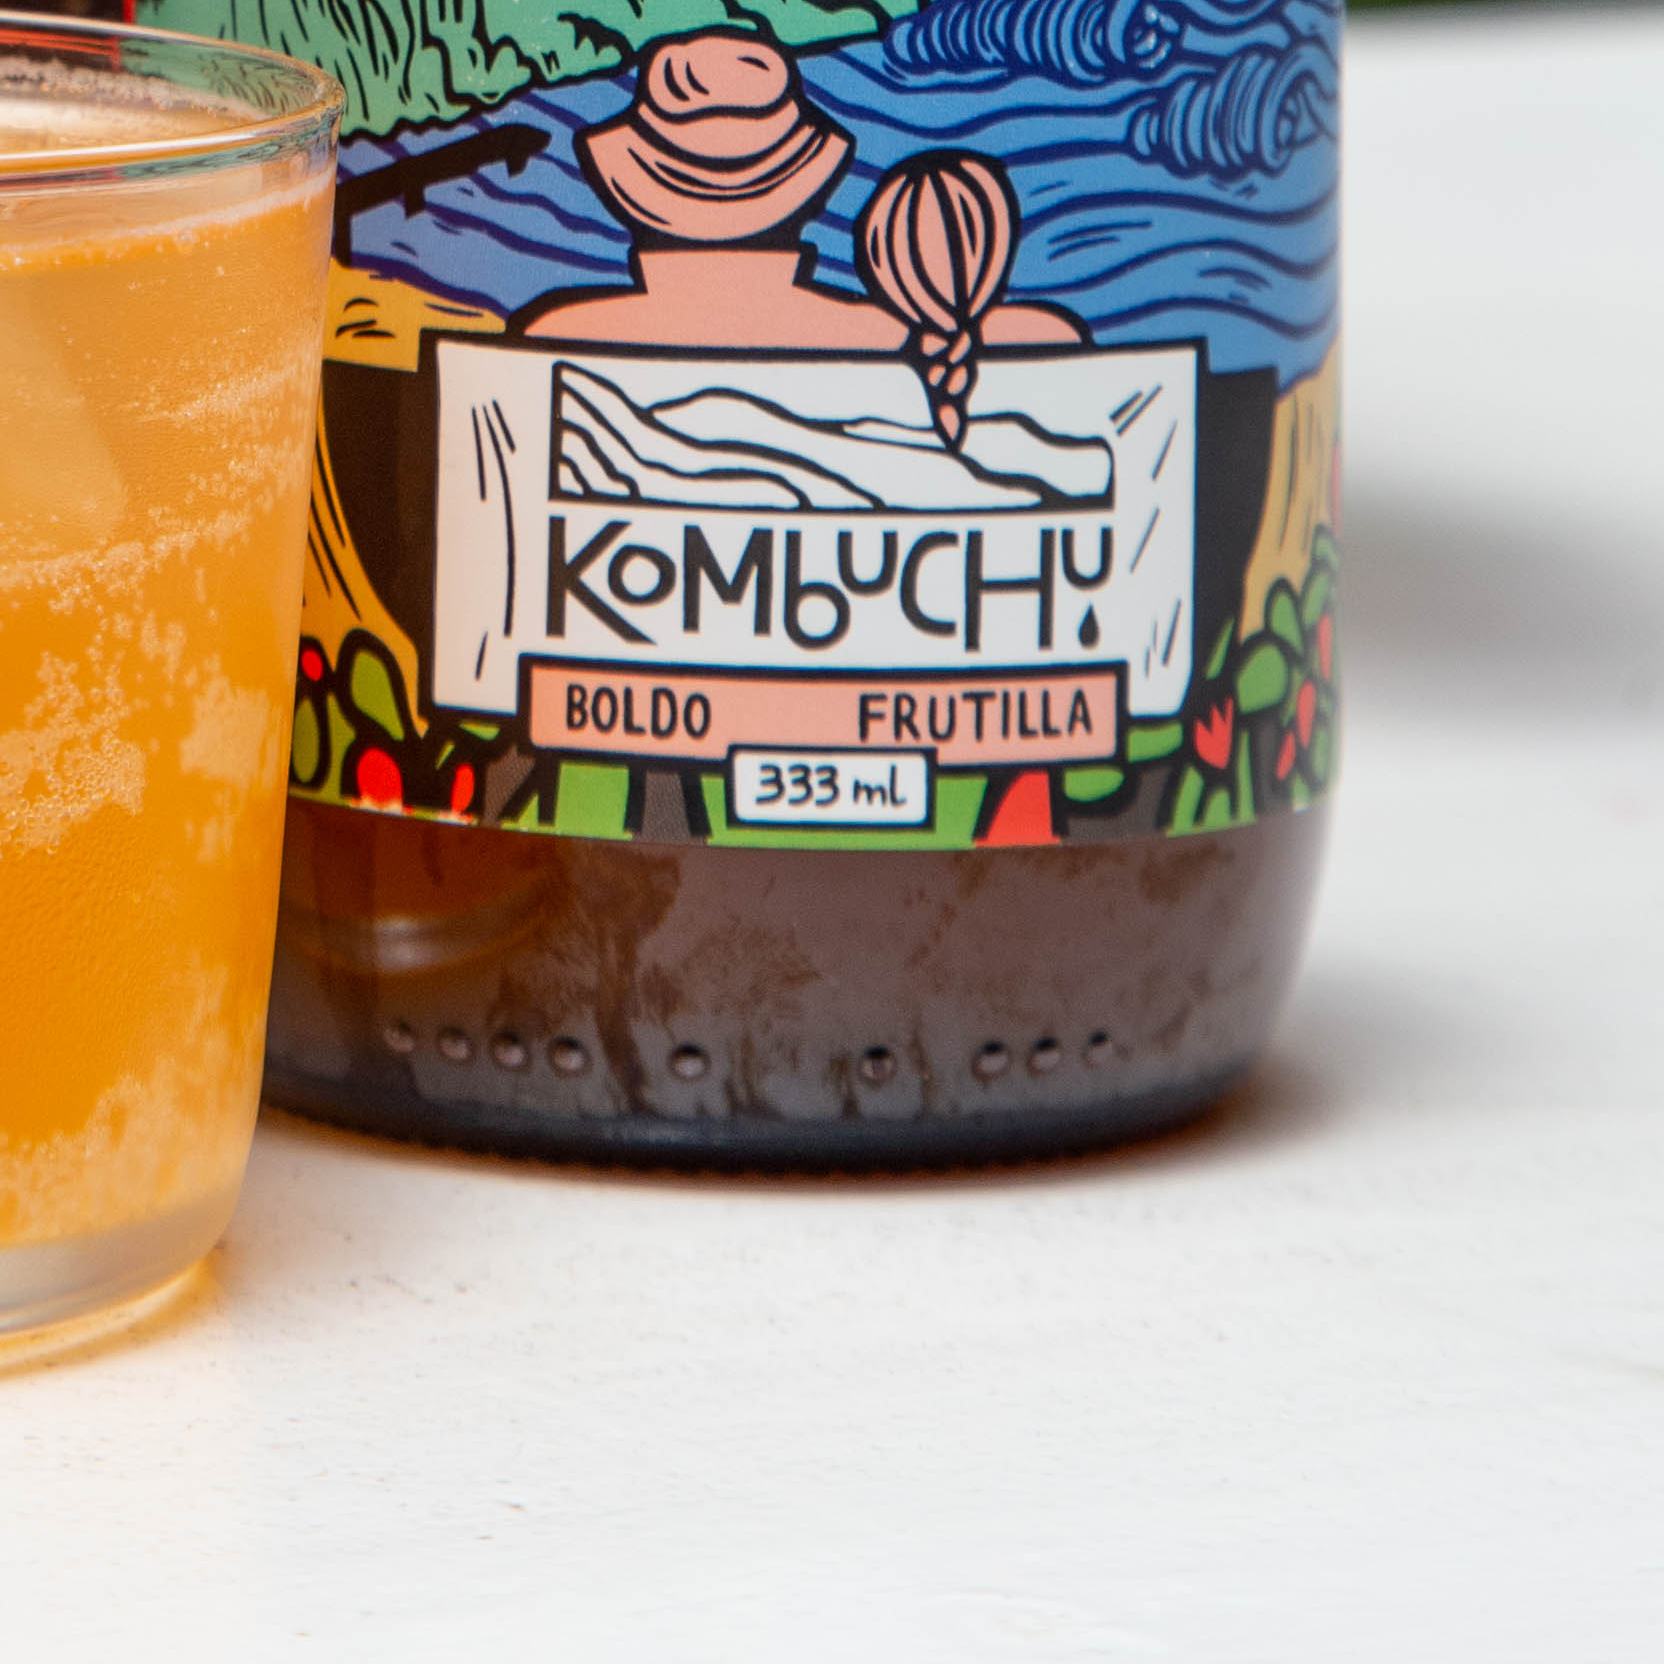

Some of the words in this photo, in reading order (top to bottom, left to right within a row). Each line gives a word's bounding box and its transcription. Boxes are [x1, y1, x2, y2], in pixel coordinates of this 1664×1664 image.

[566, 683, 713, 740] BOLDO
[856, 687, 1093, 742] FRUTILLA
[754, 763, 841, 805] 333
[852, 764, 907, 805] ml
